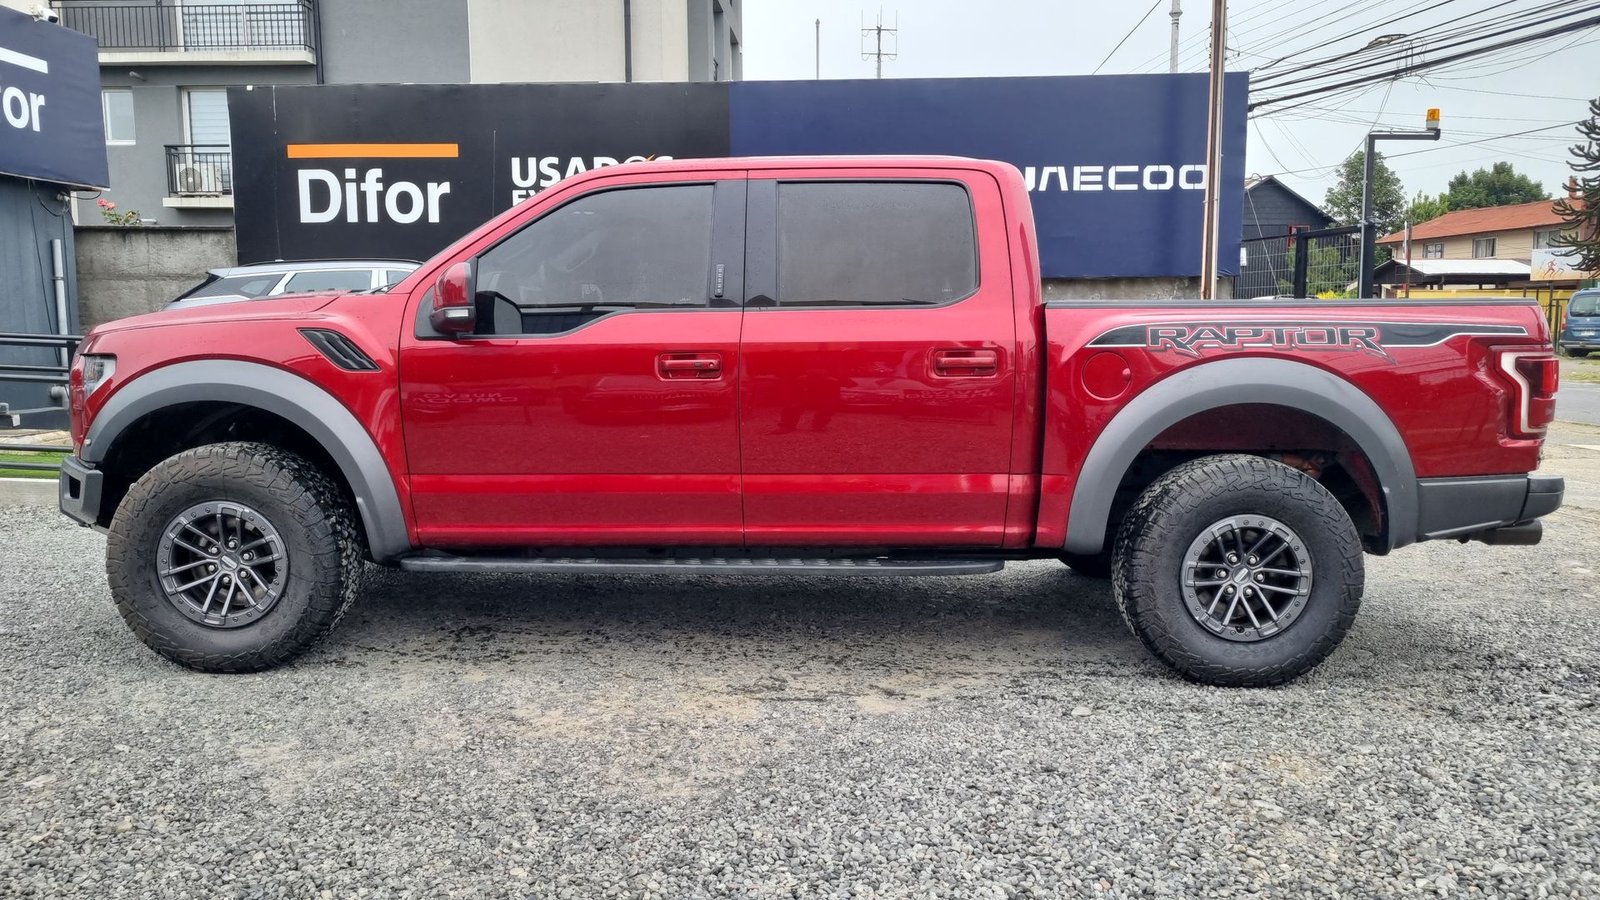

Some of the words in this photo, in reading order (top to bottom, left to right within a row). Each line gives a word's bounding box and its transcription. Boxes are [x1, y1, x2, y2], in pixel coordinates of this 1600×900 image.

[0, 86, 46, 132] or
[297, 168, 451, 224] Difor
[1147, 326, 1397, 366] RAPTOR
